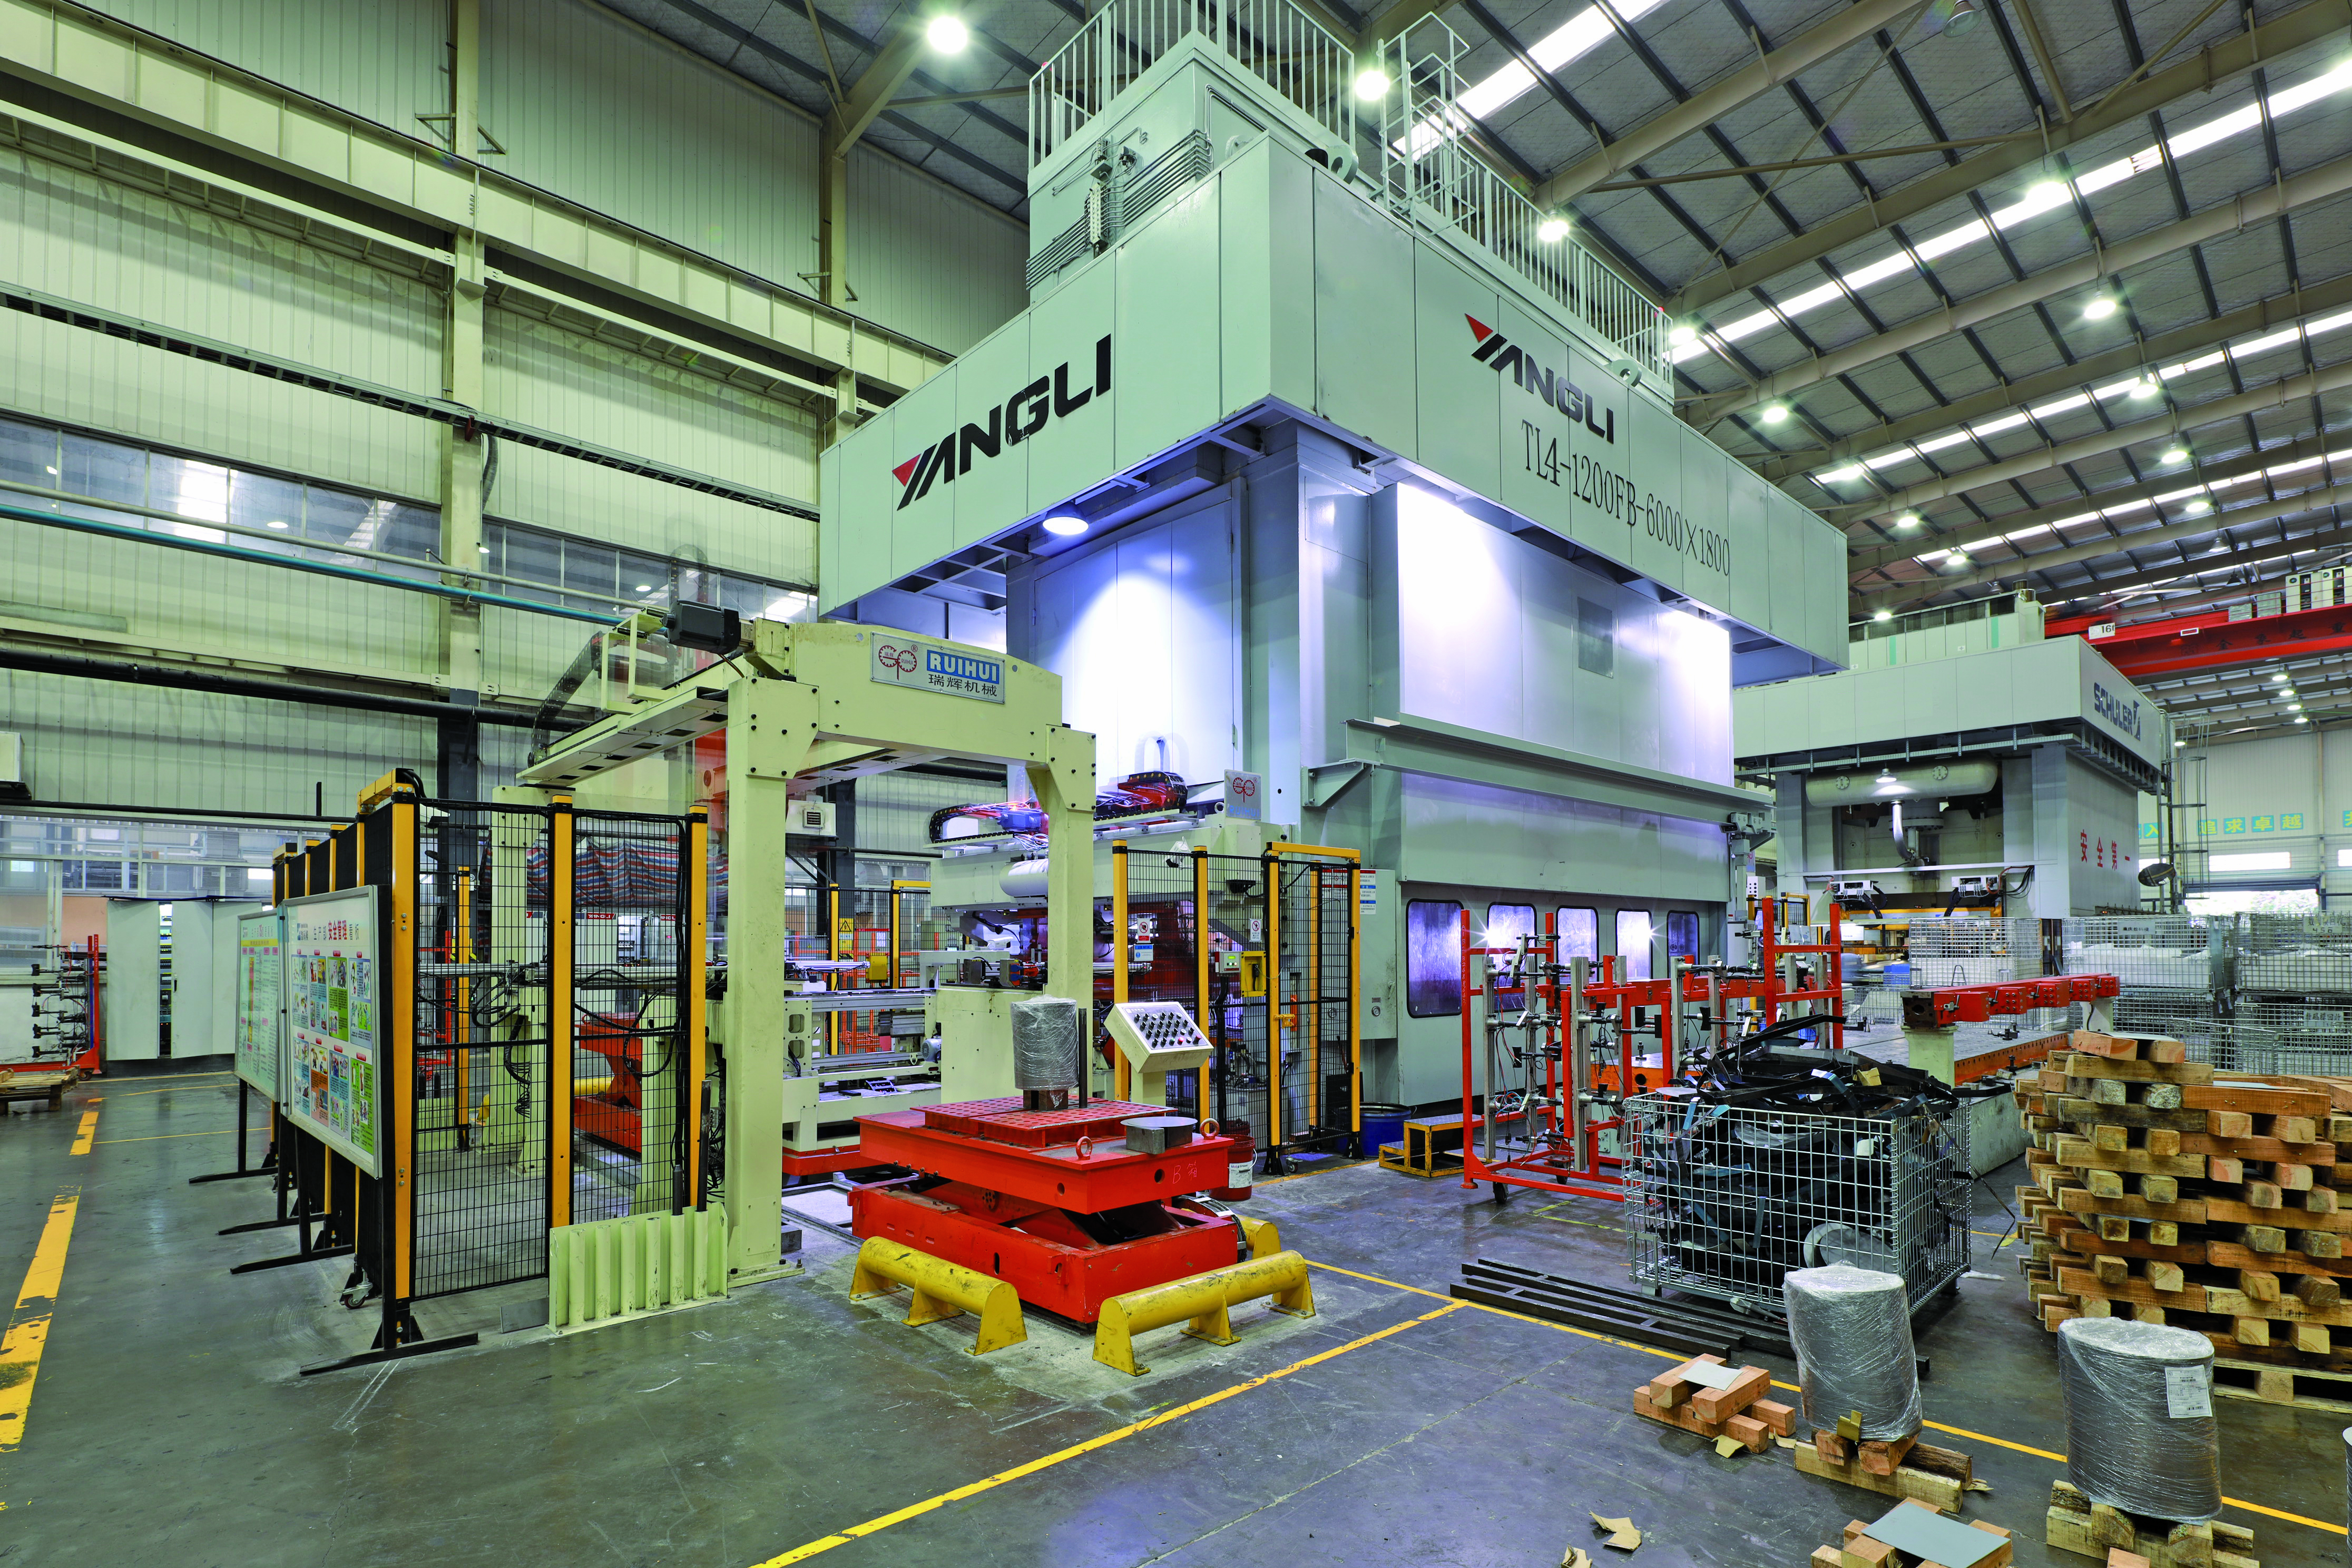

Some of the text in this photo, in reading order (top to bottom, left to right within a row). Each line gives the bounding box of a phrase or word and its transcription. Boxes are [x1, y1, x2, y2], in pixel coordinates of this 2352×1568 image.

[1465, 313, 1613, 444] YANGLI
[892, 334, 1111, 511] YANGLI
[2101, 624, 2114, 633] 16t
[930, 653, 996, 681] RUIHUI
[928, 674, 997, 697] 瑞辉机械
[2094, 682, 2132, 736] SCHULER
[1230, 805, 1259, 817] RUIHUI
[2199, 815, 2302, 835] 追求卓越
[2081, 829, 2130, 870] 安全第一
